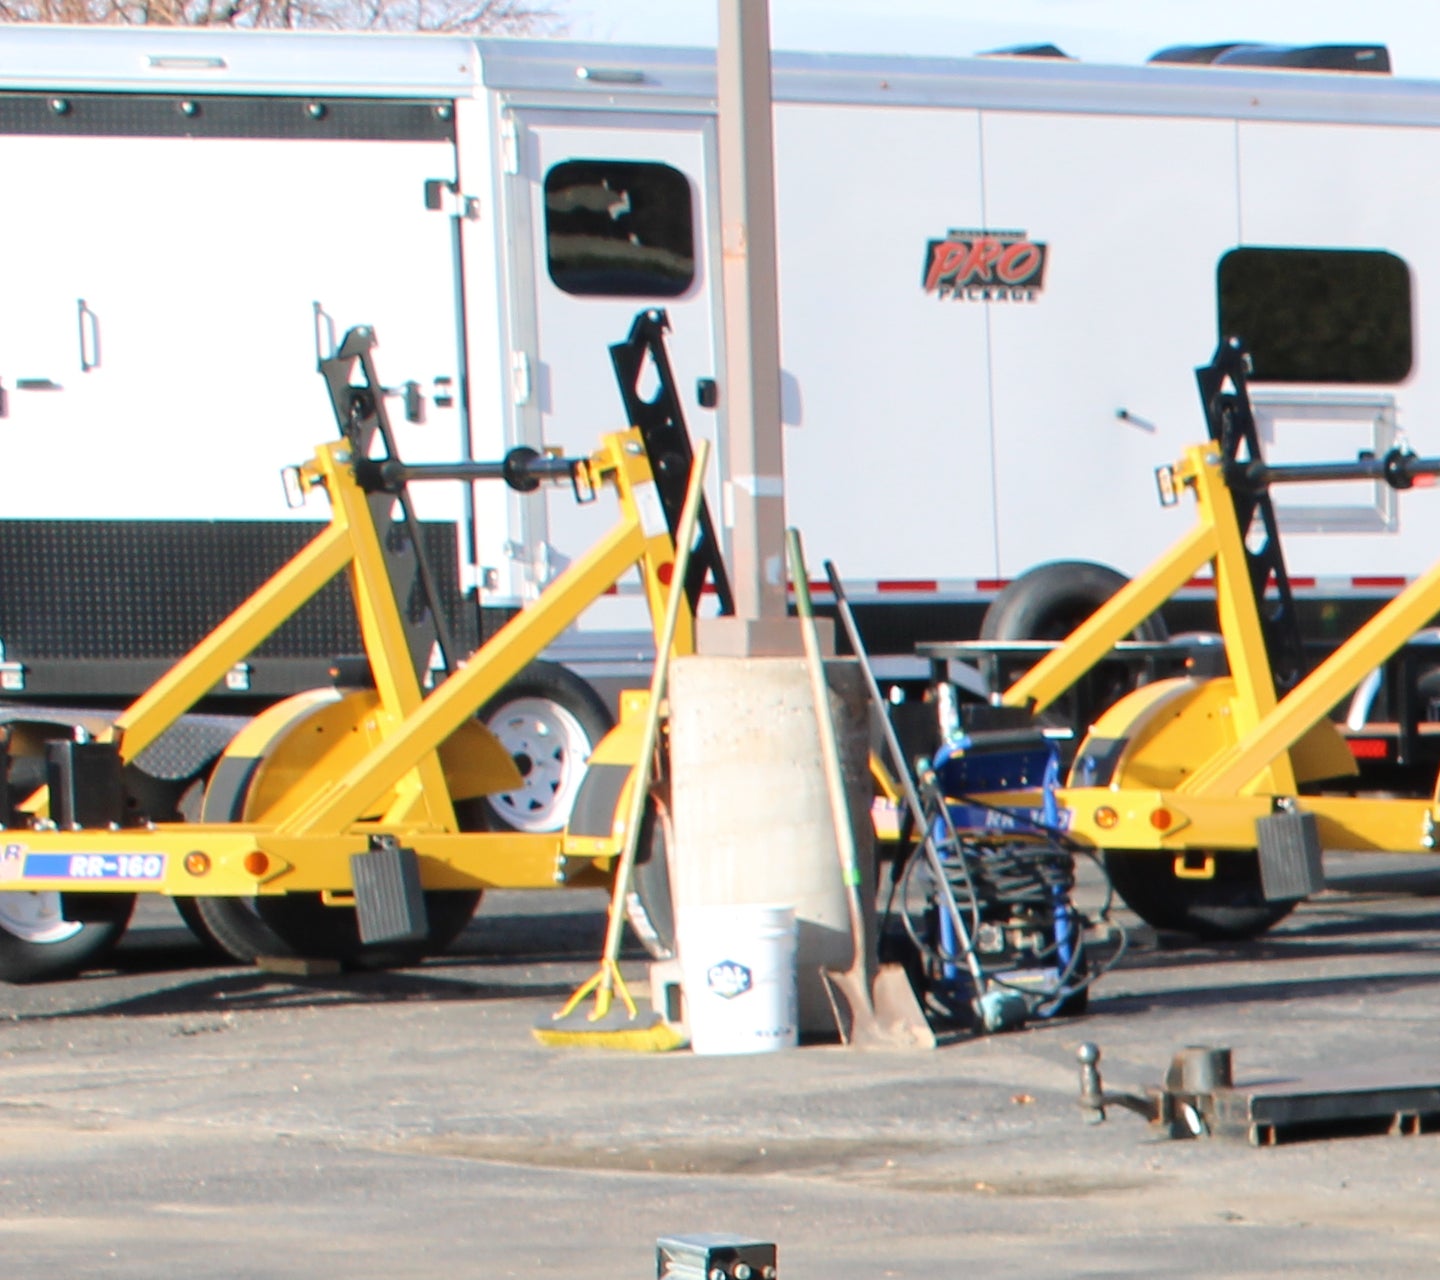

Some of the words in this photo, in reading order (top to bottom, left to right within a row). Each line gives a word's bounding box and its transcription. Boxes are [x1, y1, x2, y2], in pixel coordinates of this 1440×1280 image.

[925, 236, 1041, 292] PRO
[939, 285, 1037, 302] PACKAGE
[69, 856, 162, 877] RR-160
